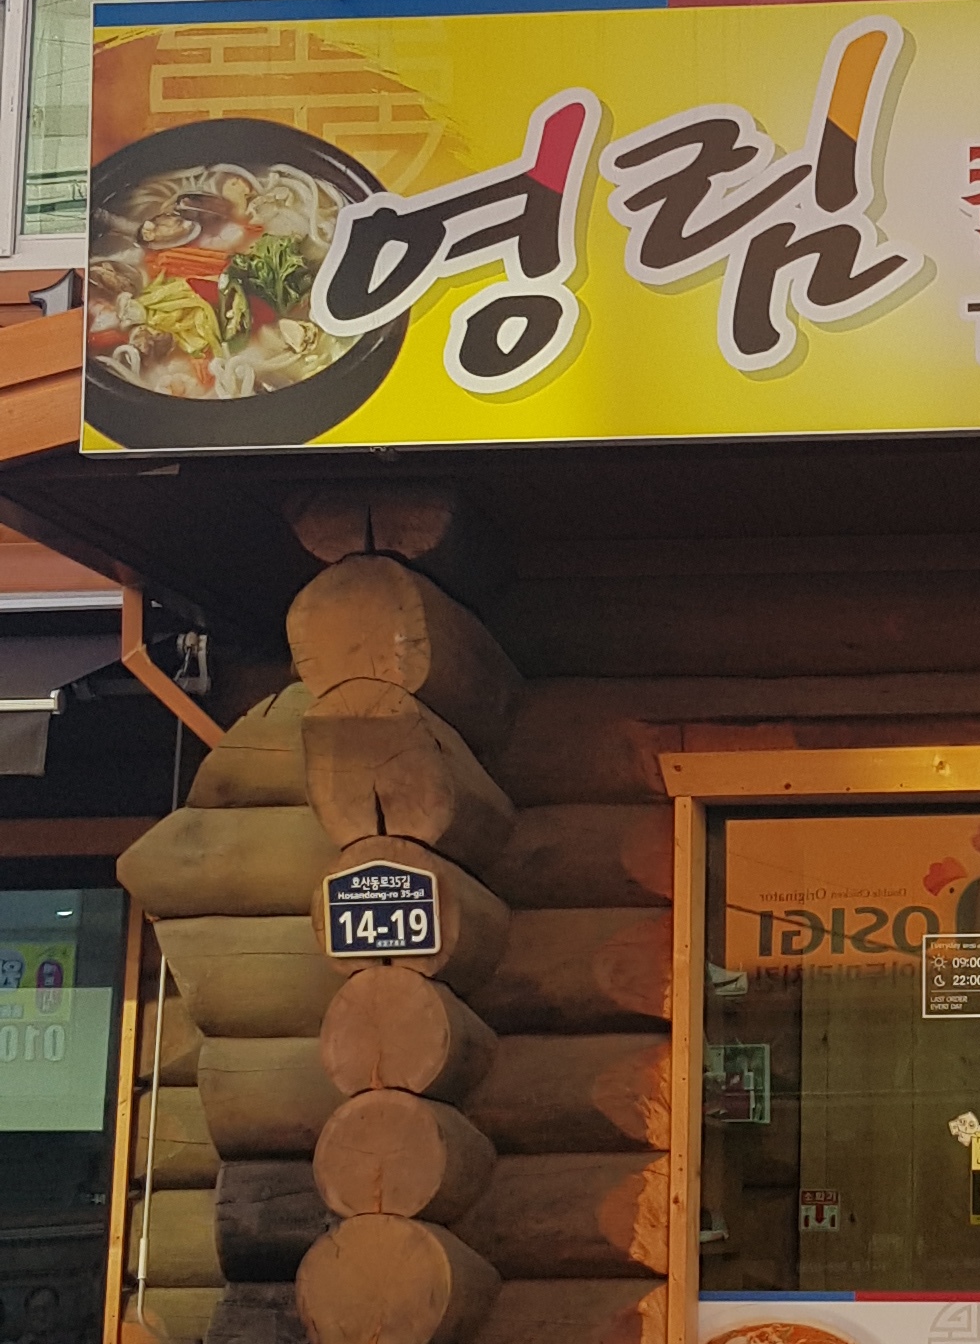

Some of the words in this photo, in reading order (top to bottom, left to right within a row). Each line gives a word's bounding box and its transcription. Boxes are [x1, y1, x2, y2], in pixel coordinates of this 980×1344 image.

[326, 30, 908, 378] 영림
[337, 890, 399, 900] Hosandong-ro
[400, 889, 425, 899] 35-gil
[351, 875, 410, 890] 호산동로35길
[338, 908, 428, 945] 14-19
